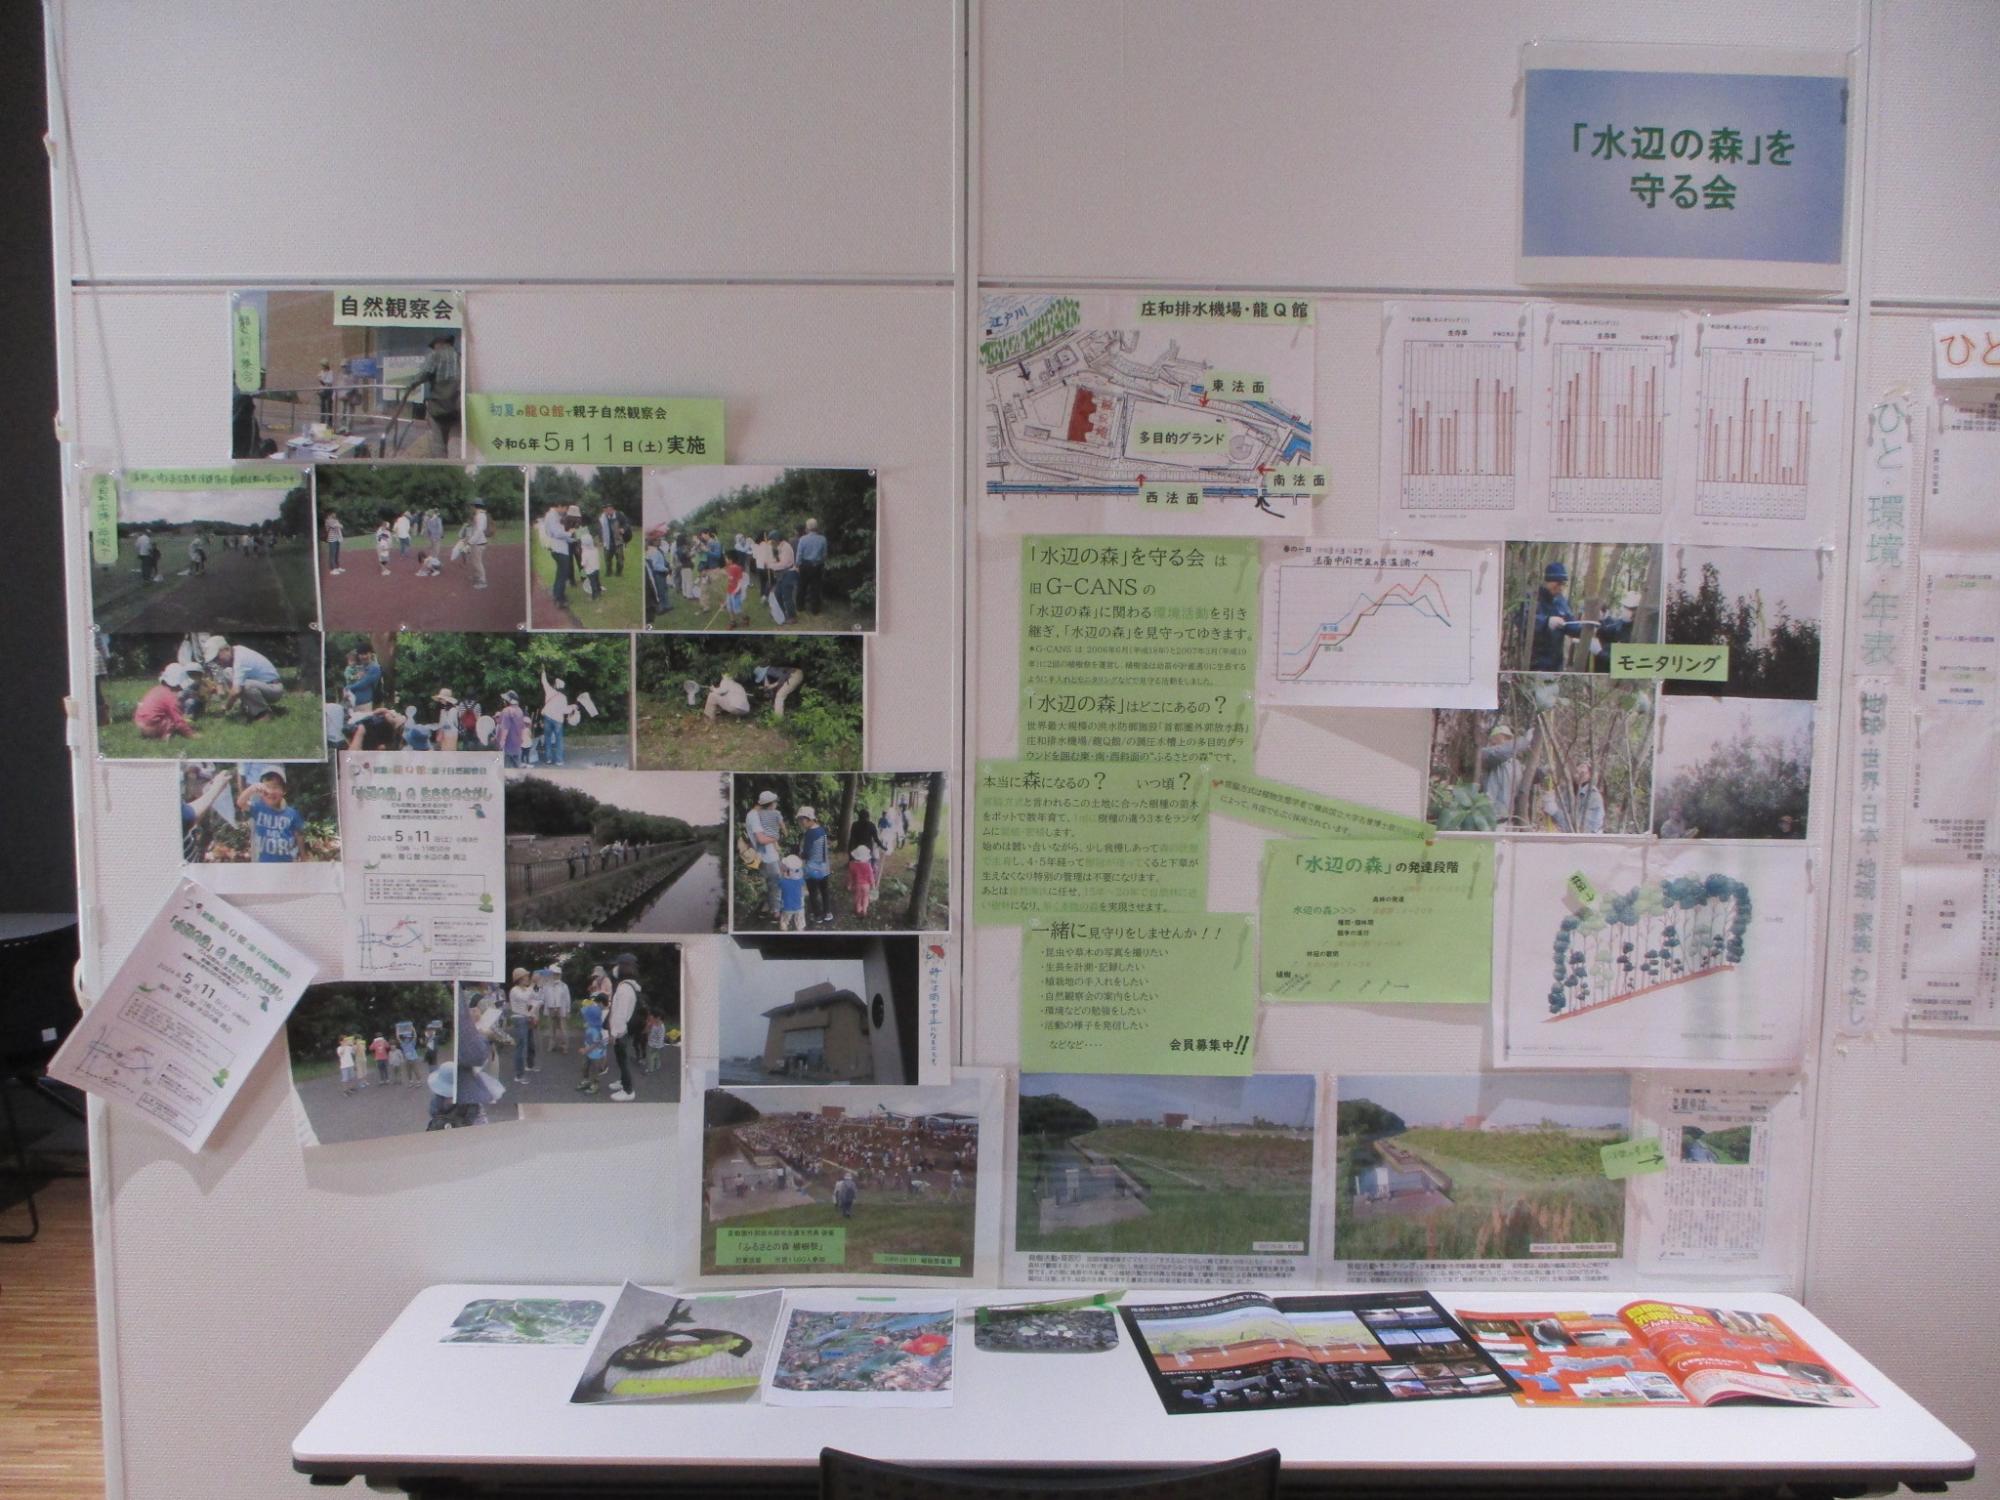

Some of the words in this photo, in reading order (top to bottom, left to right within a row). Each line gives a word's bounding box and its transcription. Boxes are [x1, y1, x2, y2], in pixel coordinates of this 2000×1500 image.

[1573, 122, 1795, 166] 「水辺の森」を
[1630, 172, 1737, 210] 守る会
[341, 296, 454, 320] 自然観察会
[1141, 301, 1308, 318] 庄和排水機場・龍Q館
[1212, 379, 1264, 394] 東法面
[1139, 431, 1225, 446] 多目的グランド
[1273, 473, 1326, 487] 南法面
[1146, 492, 1199, 505] 西法面
[1618, 655, 1722, 673] モニタリング
[1296, 855, 1459, 875] 「水辺の森」の発達段階
